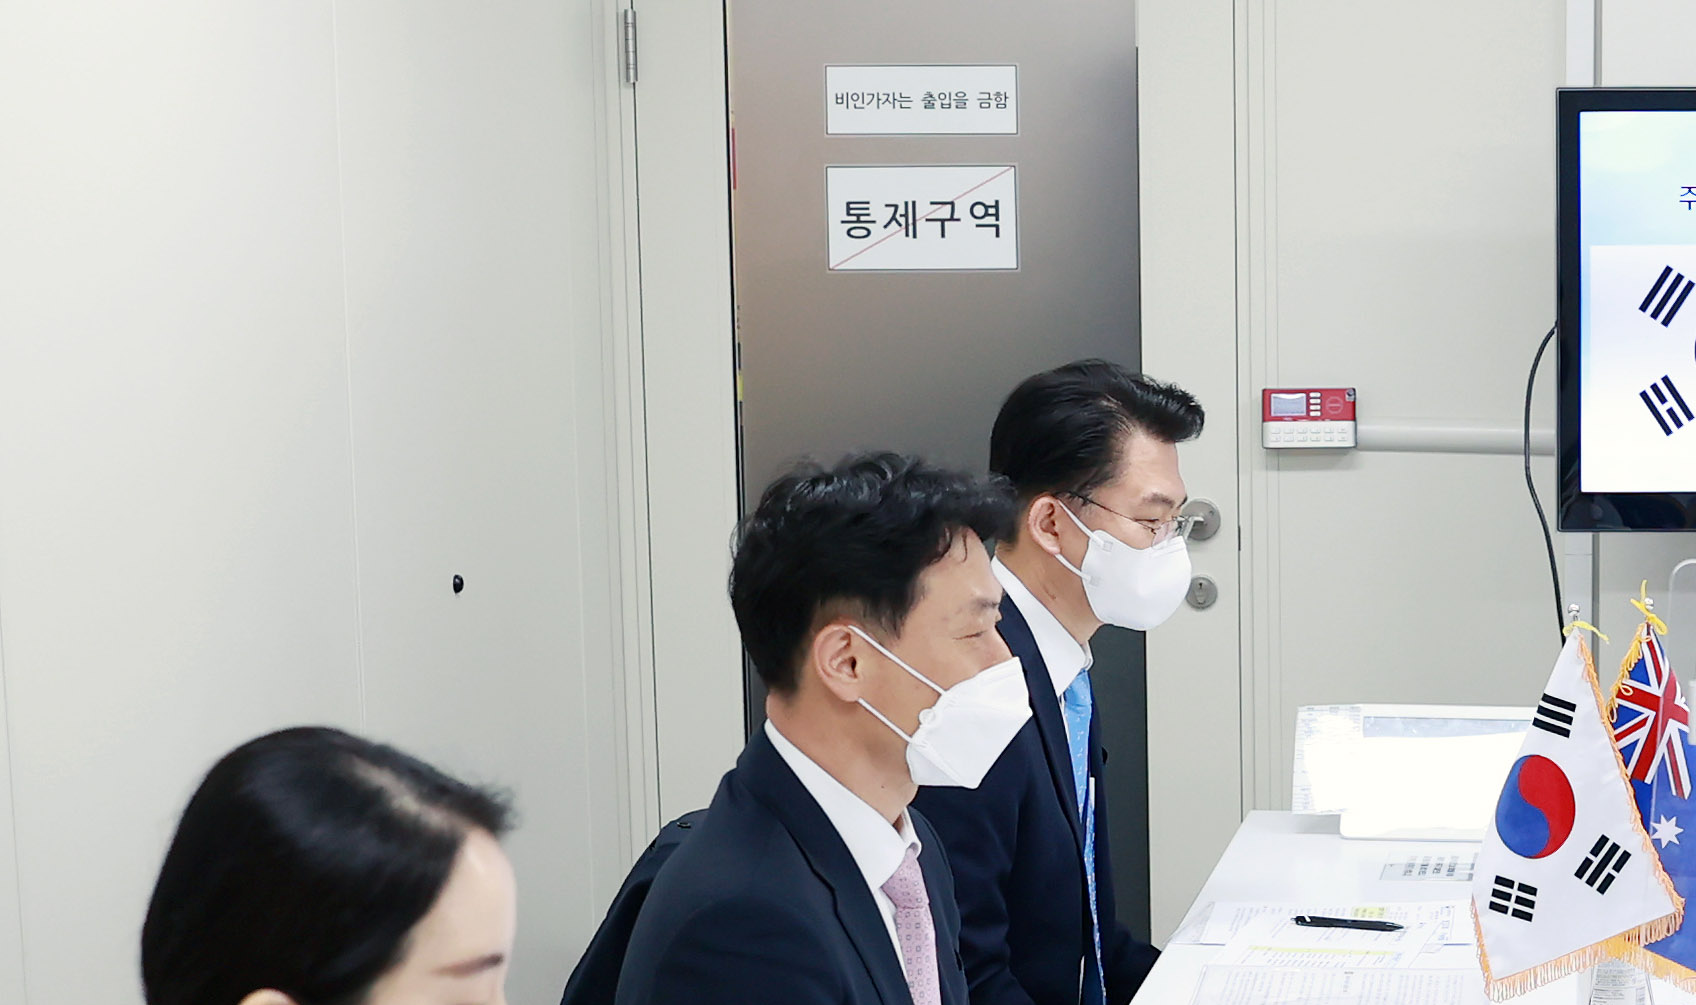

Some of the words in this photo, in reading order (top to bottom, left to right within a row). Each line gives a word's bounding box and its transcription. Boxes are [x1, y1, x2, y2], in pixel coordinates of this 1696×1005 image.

[835, 91, 913, 110] 비인가자는
[921, 91, 969, 110] 출입을
[977, 91, 1009, 110] 금함
[840, 199, 1002, 240] 통제구역
